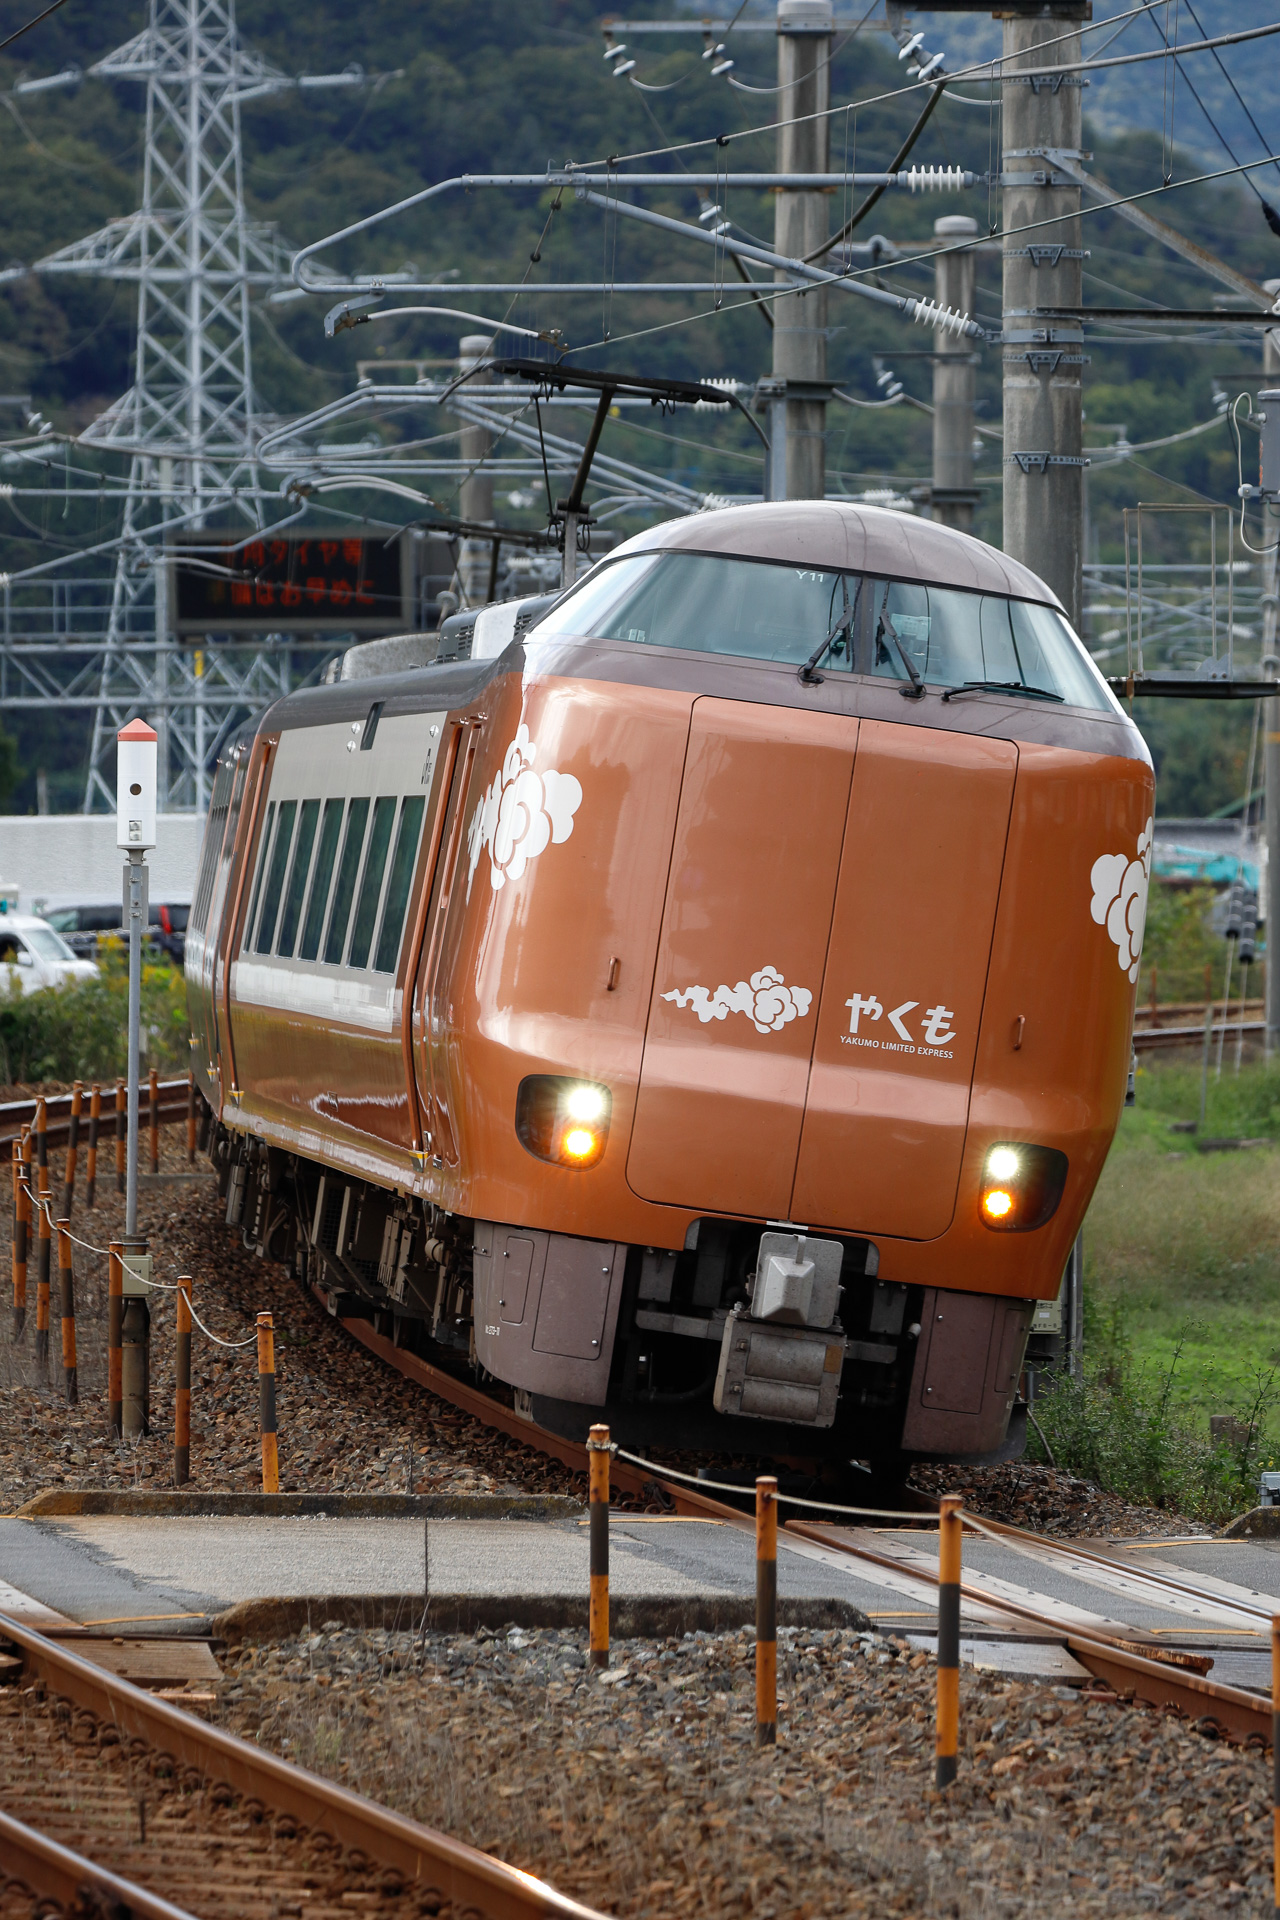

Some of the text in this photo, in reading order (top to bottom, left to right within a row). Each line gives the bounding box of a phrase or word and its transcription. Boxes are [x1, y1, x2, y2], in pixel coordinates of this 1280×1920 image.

[795, 570, 824, 583] Y11
[844, 992, 957, 1046] やくも
[840, 1035, 954, 1059] YAKUMO LIMITED EXPRESS
